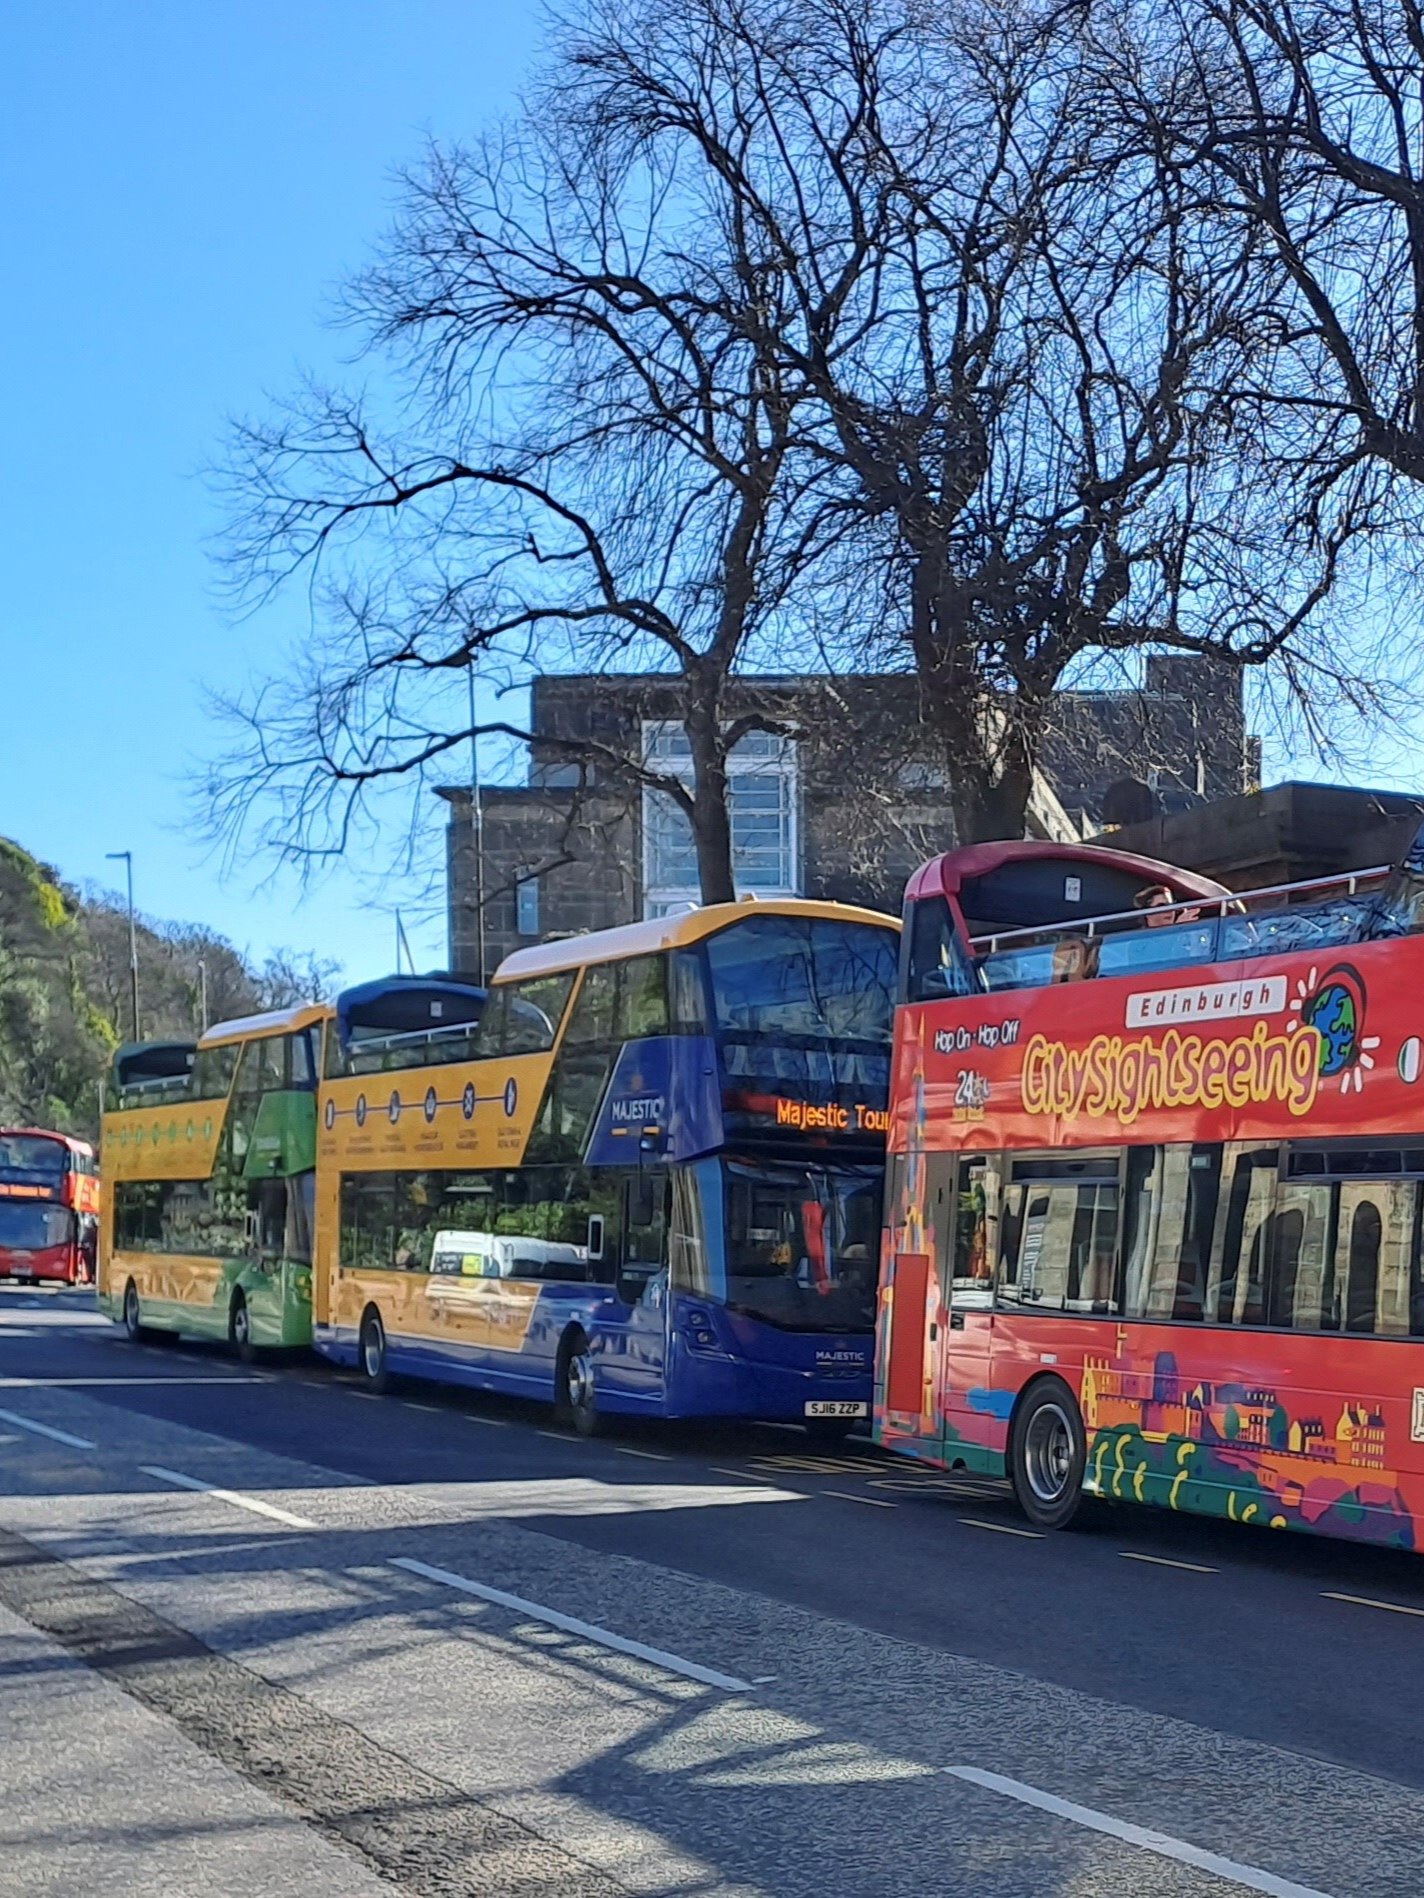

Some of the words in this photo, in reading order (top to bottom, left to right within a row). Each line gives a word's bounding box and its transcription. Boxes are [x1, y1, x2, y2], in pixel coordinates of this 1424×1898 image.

[1140, 984, 1271, 1018] Edinburgh
[934, 1030, 955, 1054] Hop
[956, 1026, 971, 1050] On
[978, 1024, 1000, 1048] Hop
[1001, 1019, 1020, 1044] Off
[611, 1097, 665, 1121] MAJESTIC
[776, 1098, 848, 1130] Majestic
[816, 1351, 864, 1361] MAJESTIC
[811, 1402, 836, 1415] SJ16
[838, 1402, 859, 1415] ZZP
